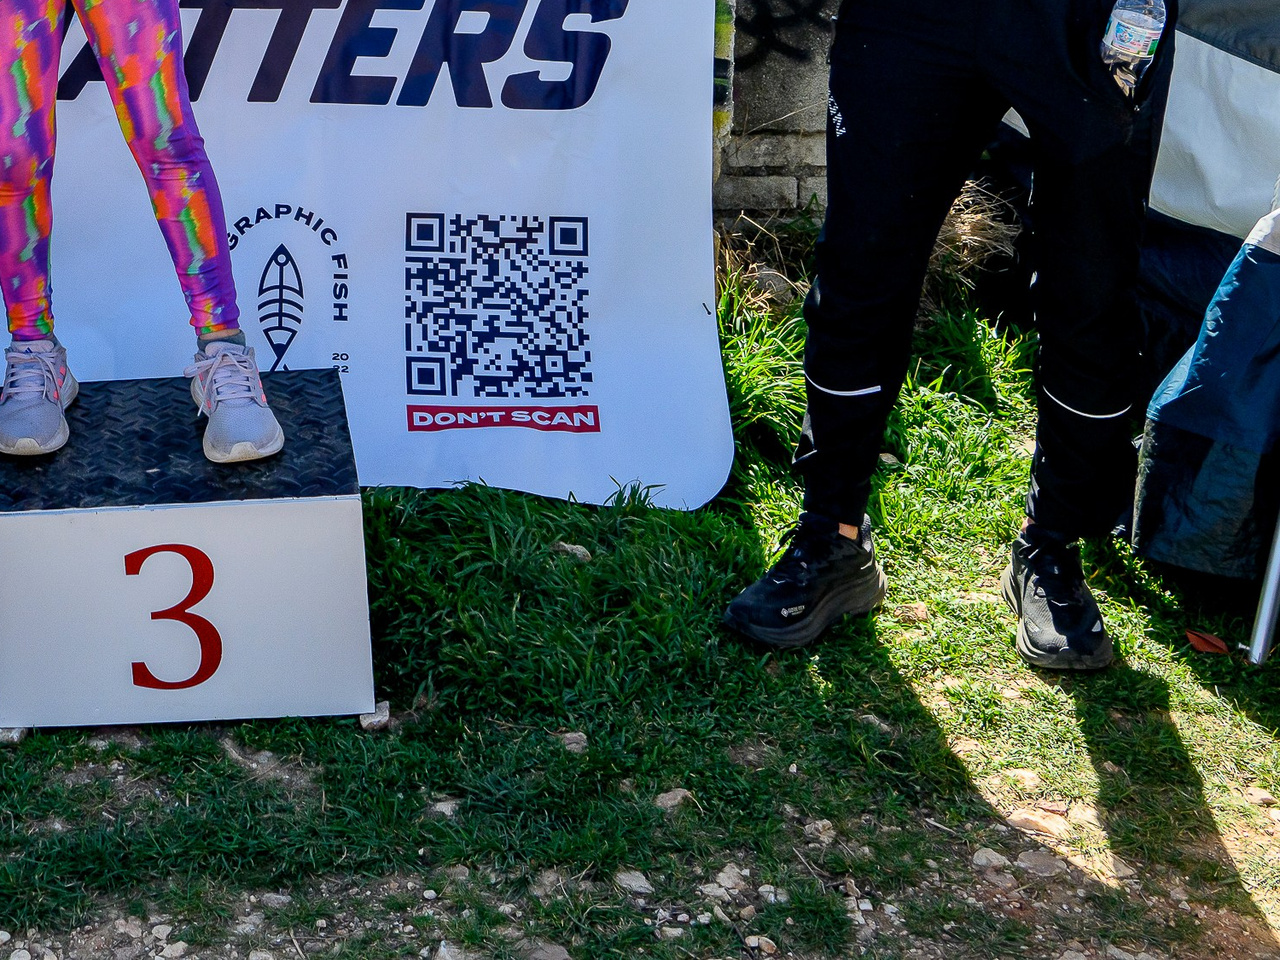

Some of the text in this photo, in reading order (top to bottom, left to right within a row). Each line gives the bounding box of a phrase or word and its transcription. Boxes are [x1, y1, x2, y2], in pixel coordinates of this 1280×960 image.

[227, 203, 349, 322] GRAPHIC FISH
[332, 352, 349, 361] 20
[412, 410, 595, 427] DON'T SCAN
[124, 543, 223, 690] 3
